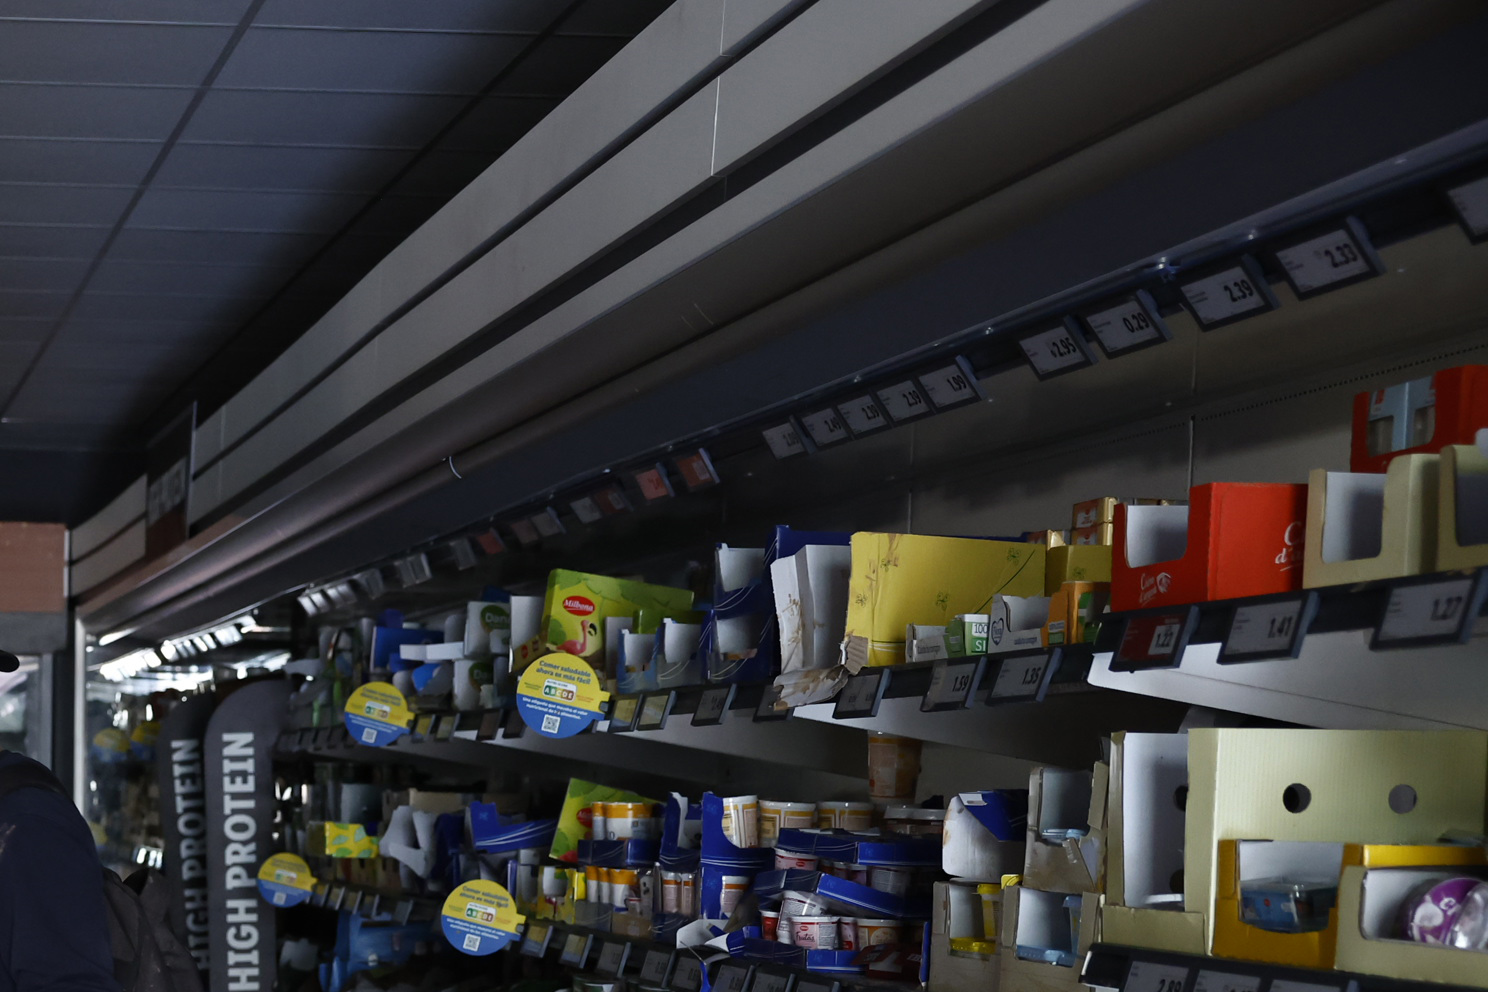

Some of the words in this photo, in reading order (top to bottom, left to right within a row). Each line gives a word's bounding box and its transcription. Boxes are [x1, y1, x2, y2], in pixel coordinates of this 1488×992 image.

[563, 599, 594, 611] Milbona
[171, 738, 208, 880] PROTEIN
[221, 732, 258, 886] PROTEIN
[226, 898, 260, 992] HIGH
